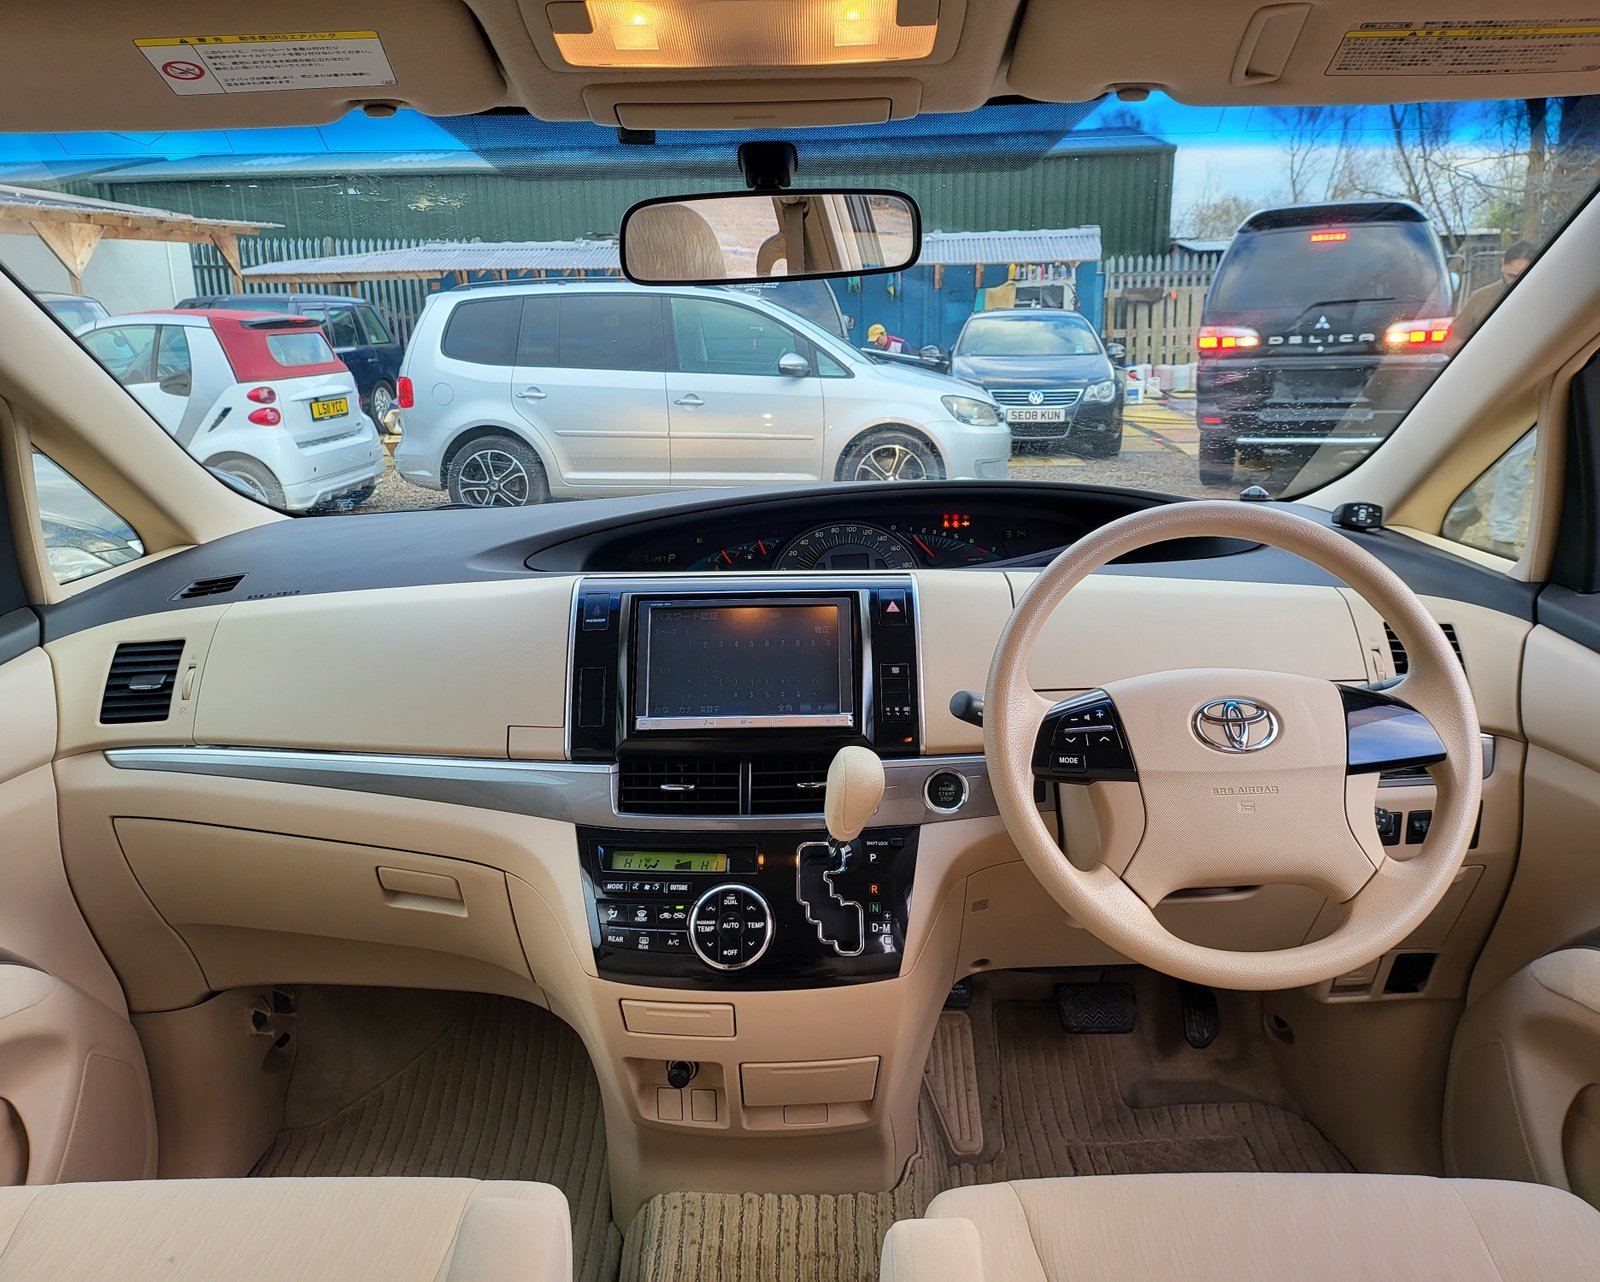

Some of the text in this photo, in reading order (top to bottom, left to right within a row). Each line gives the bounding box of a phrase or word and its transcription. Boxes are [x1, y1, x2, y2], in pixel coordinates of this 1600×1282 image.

[1268, 333, 1376, 344] DELICA
[1011, 410, 1060, 420] SE08 KUN
[870, 854, 877, 862] P
[871, 884, 878, 894] R
[872, 904, 879, 913] N
